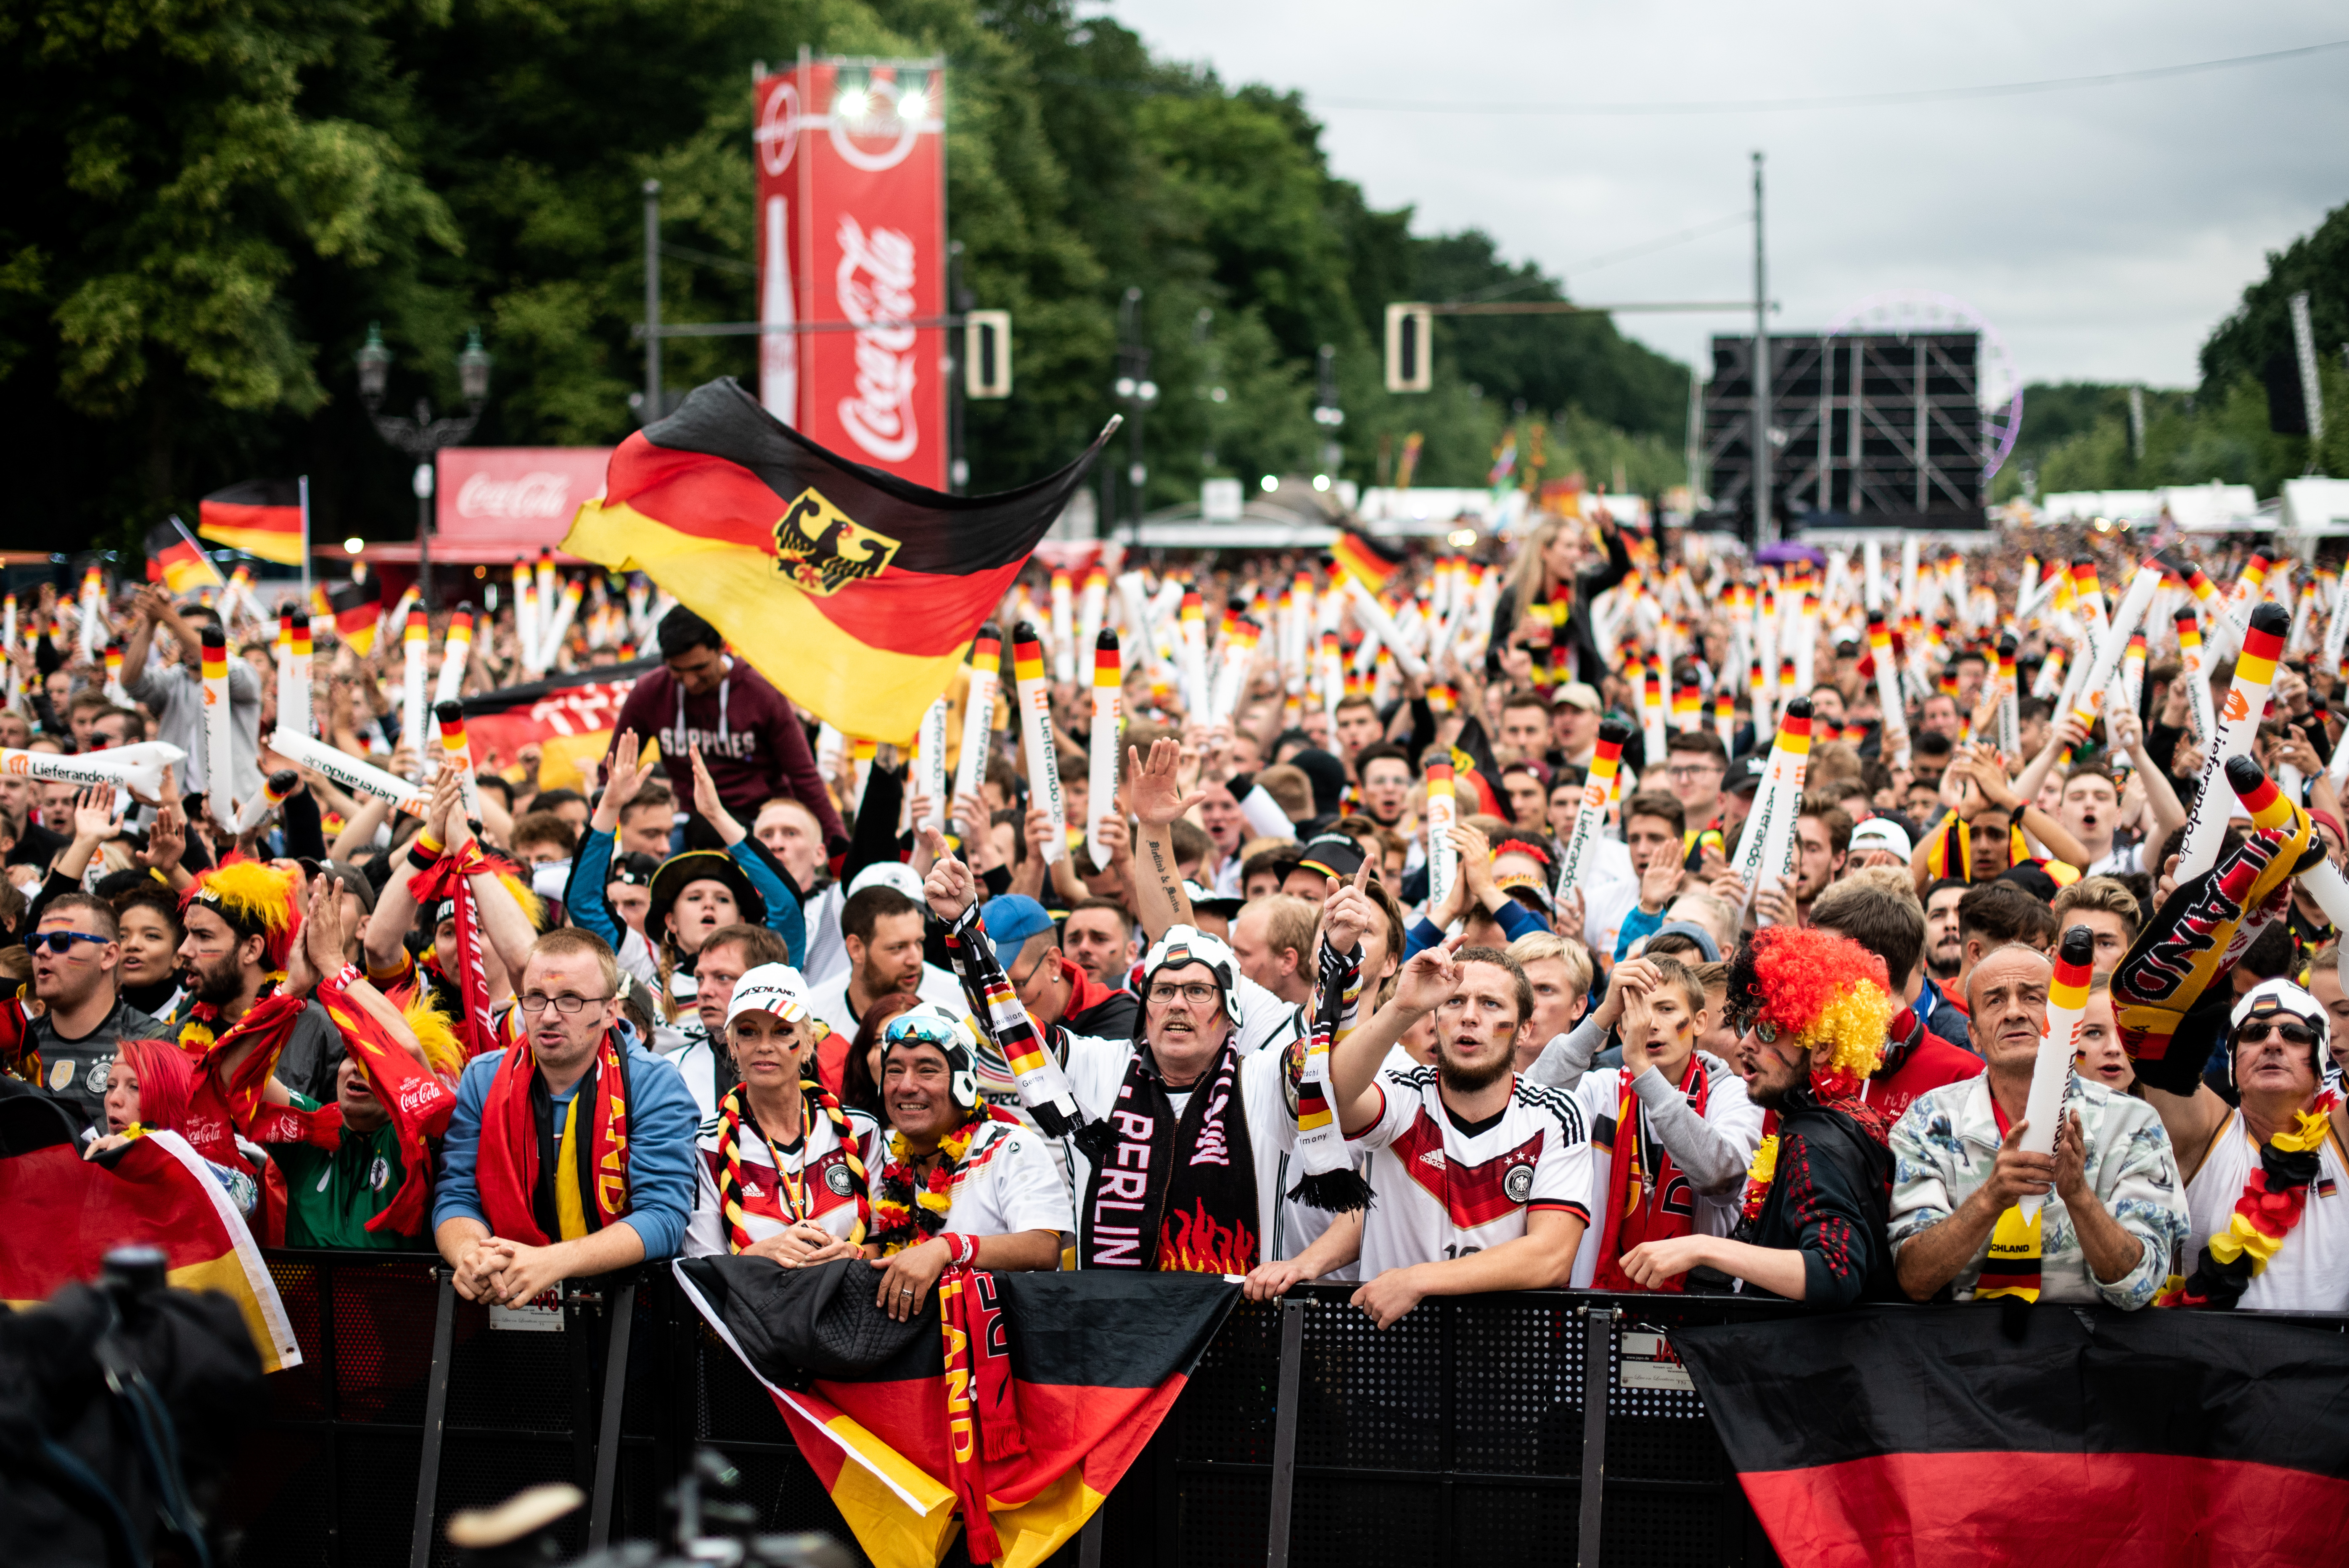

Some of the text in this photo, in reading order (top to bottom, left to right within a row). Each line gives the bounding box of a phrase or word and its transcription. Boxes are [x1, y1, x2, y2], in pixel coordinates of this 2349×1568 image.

[659, 727, 755, 758] SUPPLIES
[33, 762, 124, 786] Lieferando.de
[303, 753, 399, 806] Lieferando.de
[1040, 716, 1063, 824] Lieferando.de
[2180, 724, 2229, 863] Lieferando.de
[1562, 810, 1595, 900] Lieferando.d
[401, 1081, 440, 1112] Coca-Cola
[1419, 1155, 1447, 1170] adidas
[532, 1289, 558, 1312] PO
